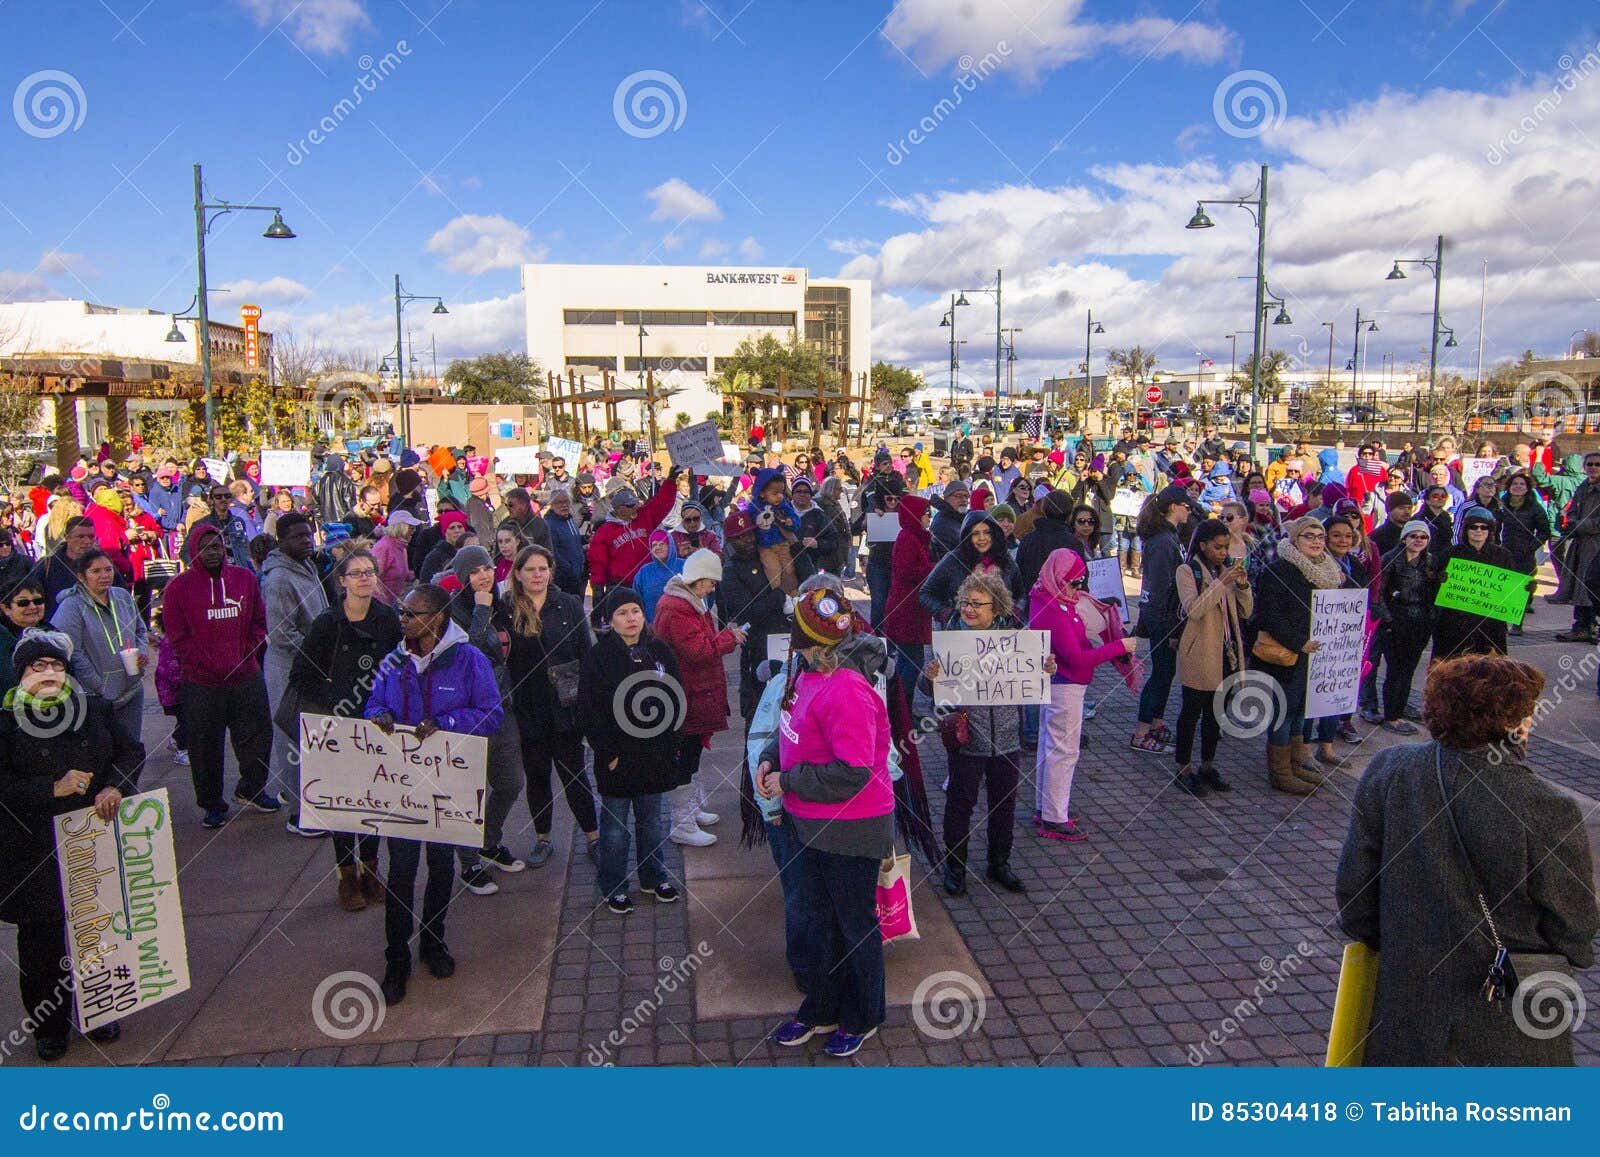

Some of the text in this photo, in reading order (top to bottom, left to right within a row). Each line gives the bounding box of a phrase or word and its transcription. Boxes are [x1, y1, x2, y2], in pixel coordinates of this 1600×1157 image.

[706, 272, 738, 284] BANK
[747, 273, 780, 284] WEST
[1147, 391, 1161, 399] STOP
[1450, 573, 1504, 592] ALL WALKS
[1452, 562, 1511, 582] WOMEN OF
[1447, 583, 1492, 599] SHOULD BE
[1445, 592, 1508, 614] REPRESENTED
[1340, 615, 1365, 635] spend
[975, 632, 1025, 655] DAPL
[937, 651, 963, 678] No
[302, 717, 469, 778] We the People
[373, 763, 413, 787] Are
[302, 778, 485, 829] Greater than Fear!
[61, 809, 116, 922] Standing
[112, 796, 178, 1003] Standing with
